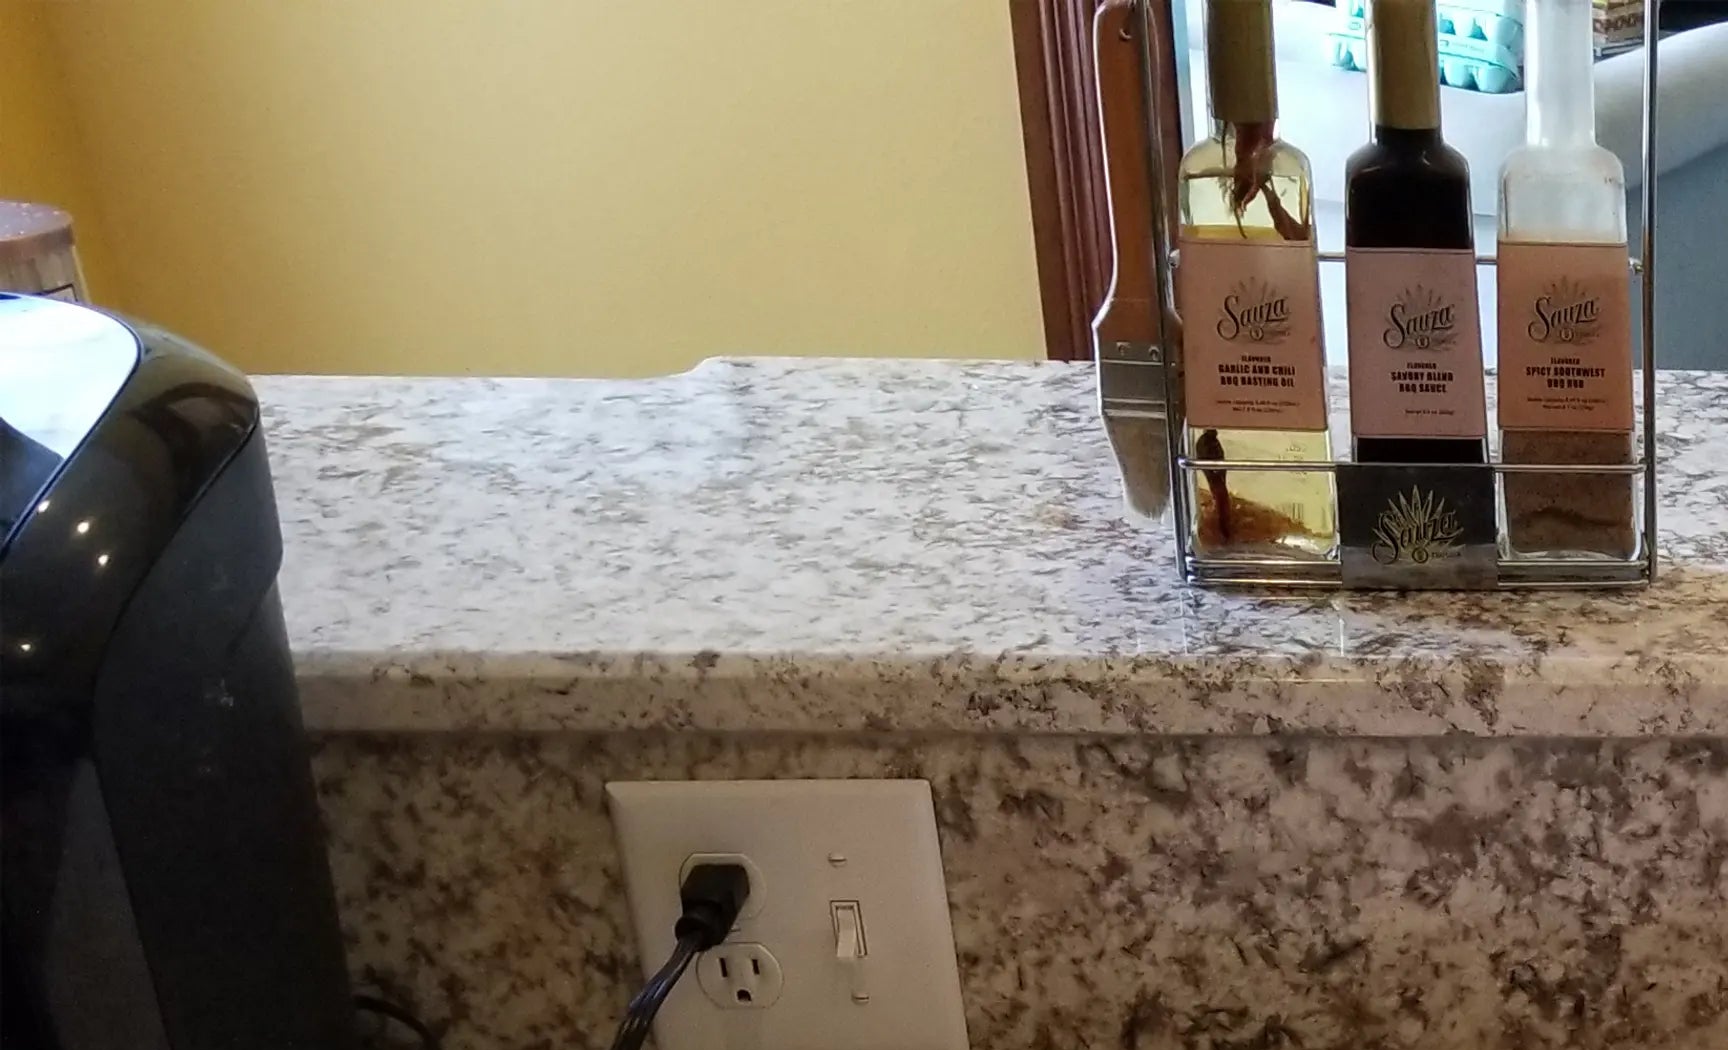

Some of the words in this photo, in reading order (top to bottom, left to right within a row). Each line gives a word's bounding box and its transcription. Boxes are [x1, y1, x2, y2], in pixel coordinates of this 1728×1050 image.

[1217, 295, 1289, 340] Sauza
[1528, 296, 1599, 342] Sauza
[1383, 303, 1456, 349] Sauza
[1218, 364, 1250, 373] GARLIC
[1252, 365, 1270, 374] AND
[1272, 366, 1295, 375] CHILI
[1526, 366, 1551, 376] SPICY
[1553, 367, 1606, 377] SOUTHWEST
[1220, 376, 1239, 386] BBQ
[1241, 376, 1279, 387] BASTING
[1281, 377, 1295, 387] OIL
[1391, 371, 1425, 381] SAVORY
[1427, 372, 1454, 381] BLEND
[1399, 383, 1417, 393] BBQ
[1419, 383, 1447, 393] SAUCE
[1547, 378, 1565, 388] BBQ
[1567, 379, 1584, 388] RUB
[1372, 511, 1464, 565] Sauza
